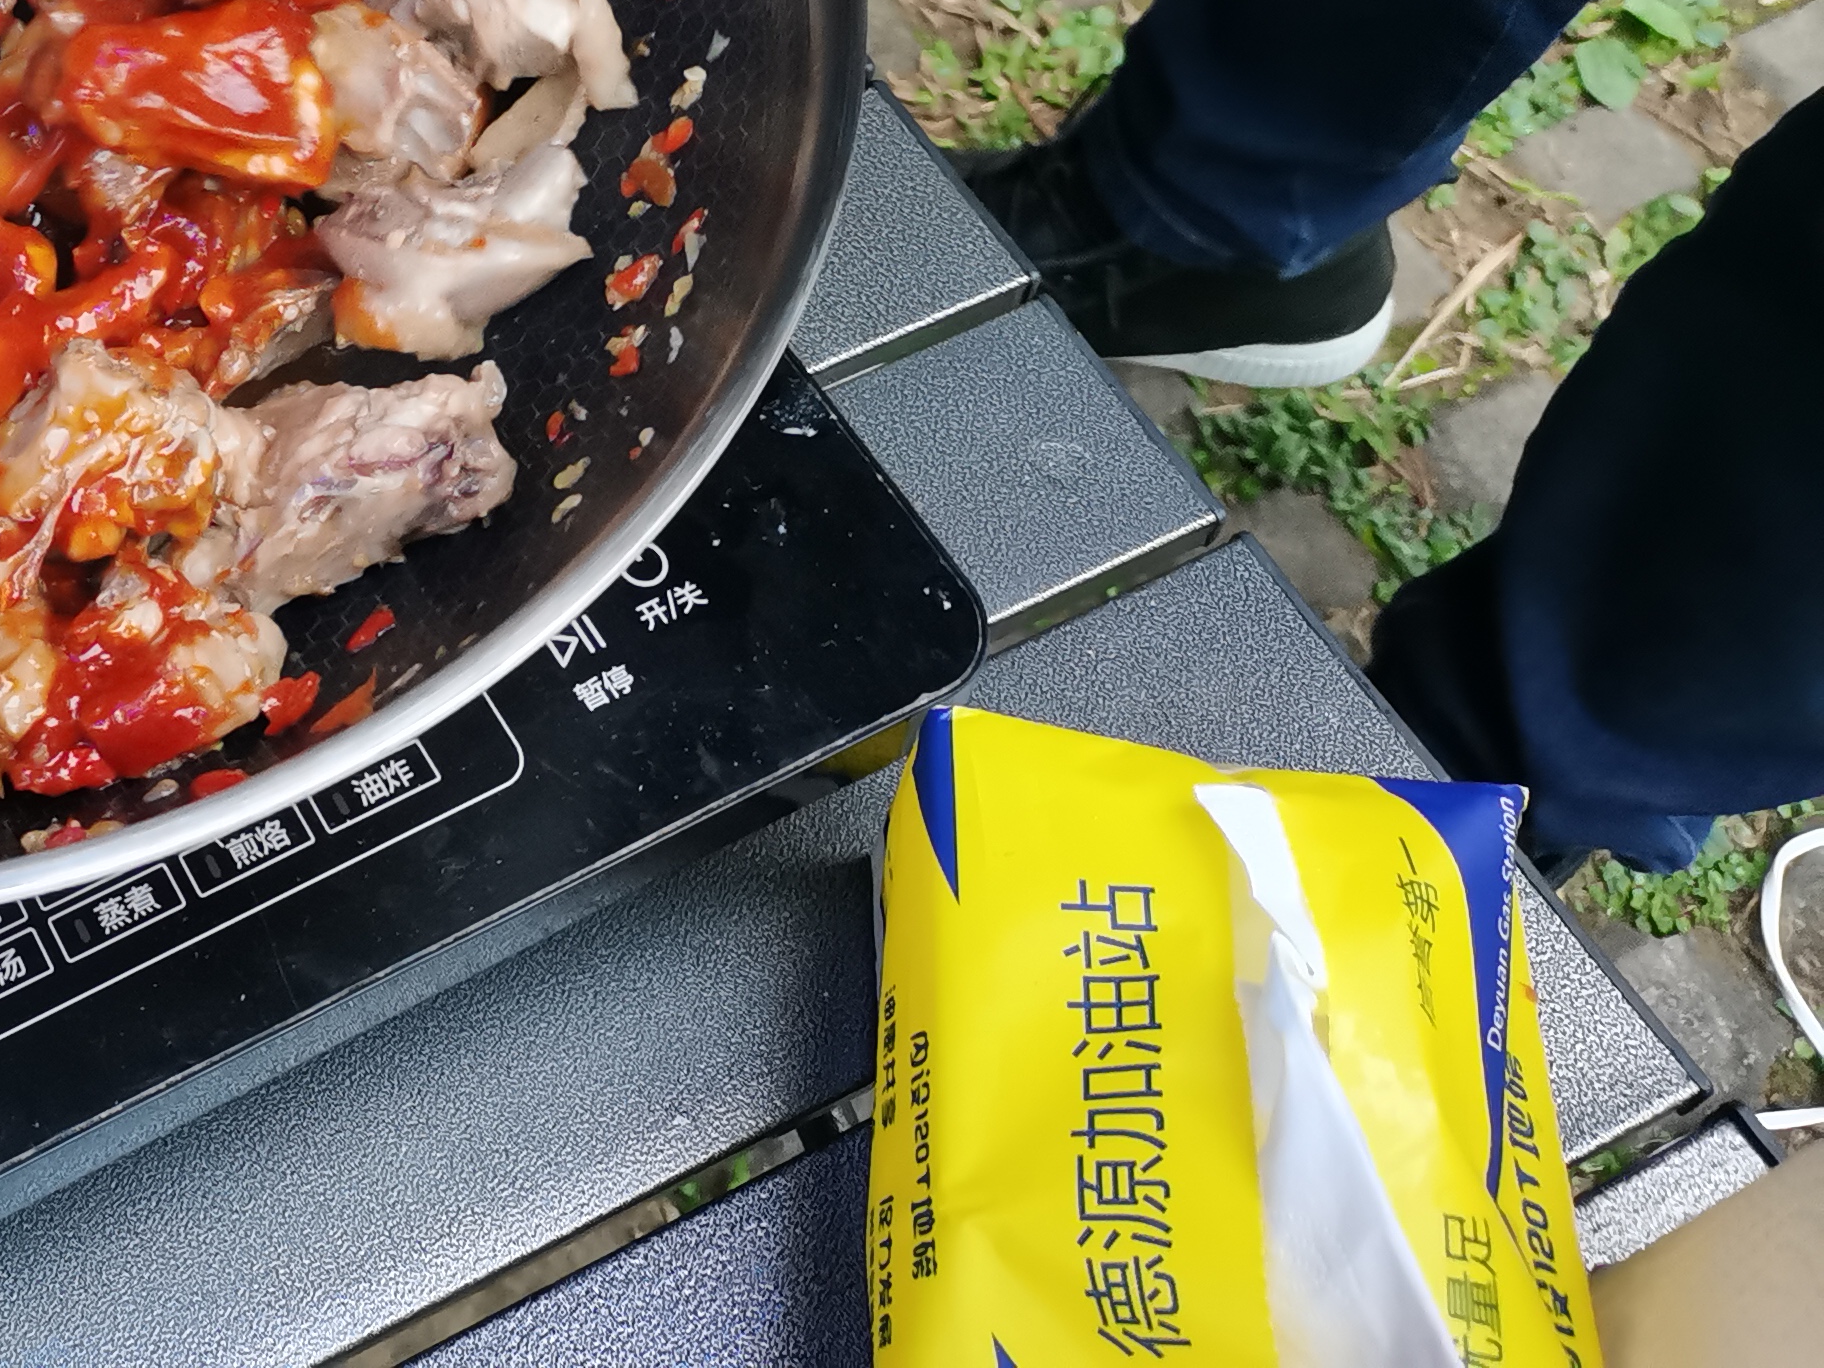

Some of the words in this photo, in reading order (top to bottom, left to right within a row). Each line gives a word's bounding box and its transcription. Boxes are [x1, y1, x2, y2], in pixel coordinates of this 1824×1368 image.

[635, 581, 709, 631] 开/关
[573, 664, 635, 712] 暂停
[351, 758, 415, 807] 油炸
[1498, 795, 1518, 884] Station
[92, 883, 162, 935] 蒸煮
[1497, 892, 1512, 942] Gas
[1486, 949, 1510, 1053] Deyuan
[1061, 879, 1192, 1359] 德源加油站
